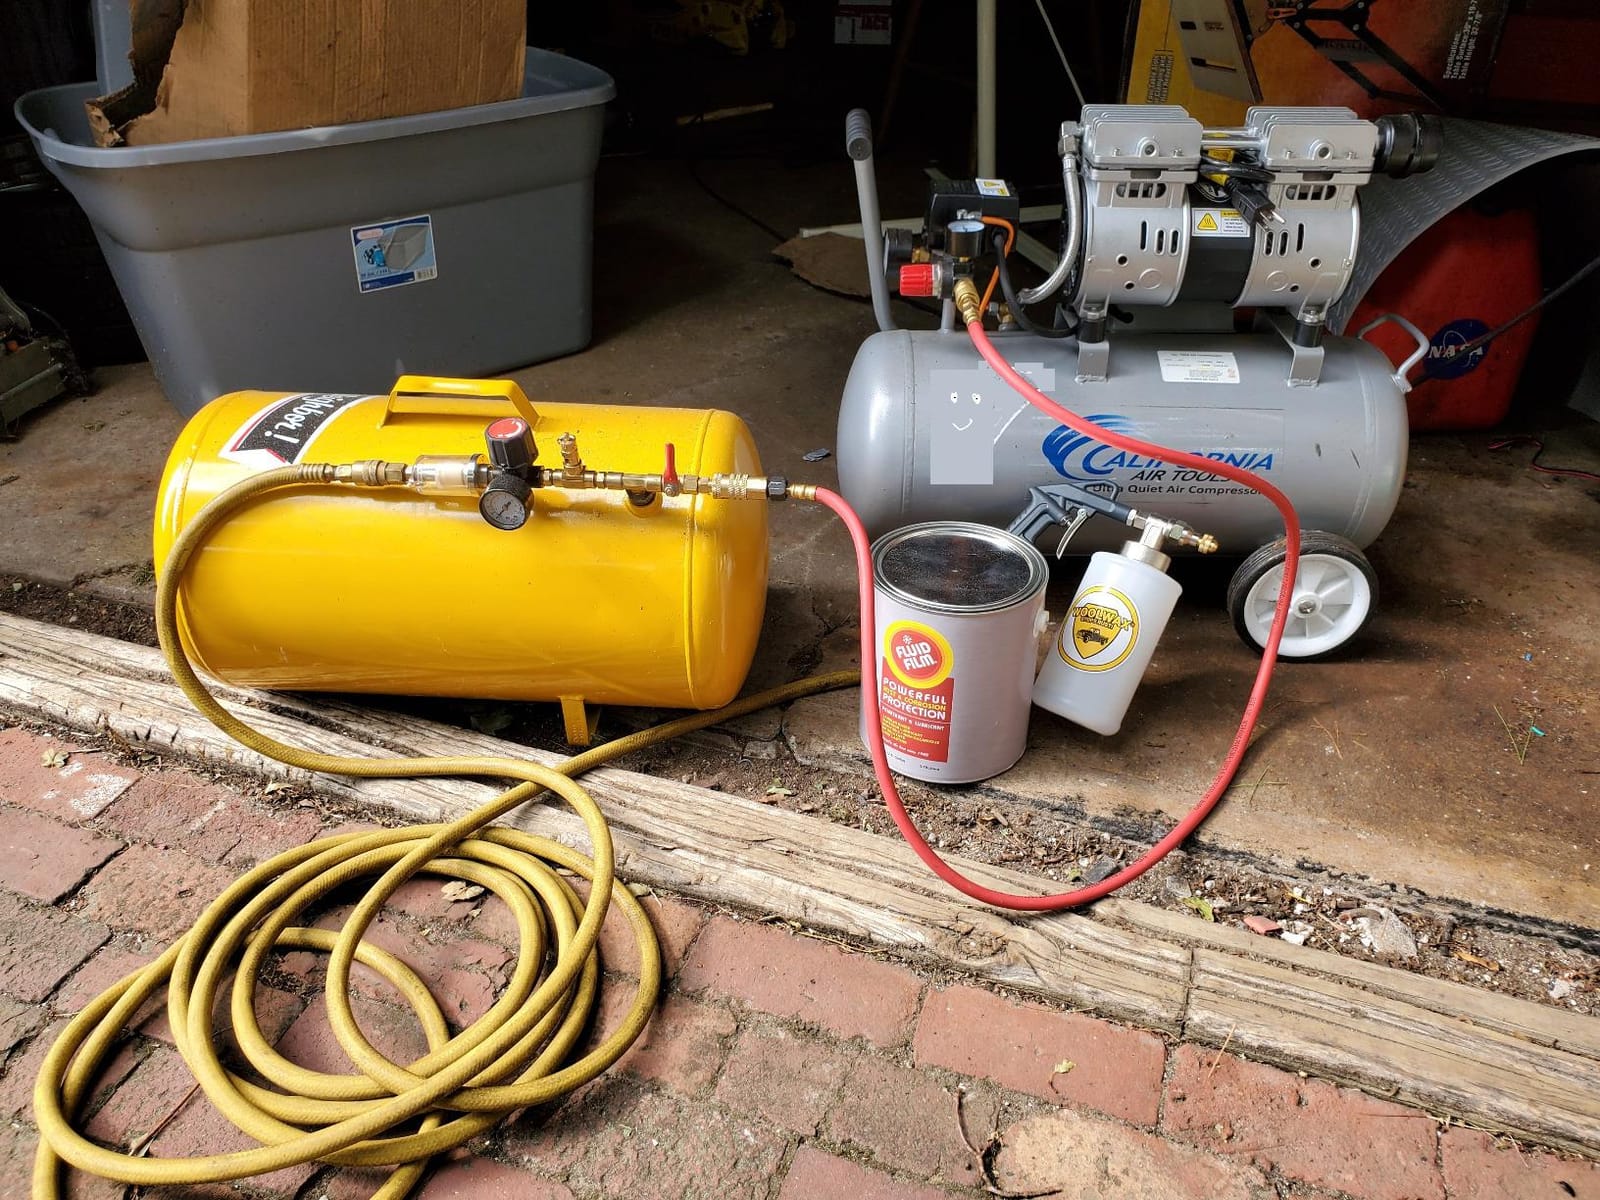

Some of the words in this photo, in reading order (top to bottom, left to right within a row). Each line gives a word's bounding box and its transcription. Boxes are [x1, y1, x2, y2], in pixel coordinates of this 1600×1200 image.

[1459, 62, 1470, 79] Table
[1082, 444, 1273, 475] CALIRNIA
[1130, 470, 1167, 481] AIR
[1172, 470, 1231, 482] TOOL
[1127, 484, 1163, 494] Quiet
[1166, 485, 1185, 494] Air
[1188, 486, 1261, 496] Compresso
[1072, 606, 1130, 632] WOOLWAX
[895, 641, 932, 659] FLUID
[883, 677, 947, 705] POWERFUL
[882, 692, 946, 720] PROTECTION
[904, 696, 946, 712] CORROSION
